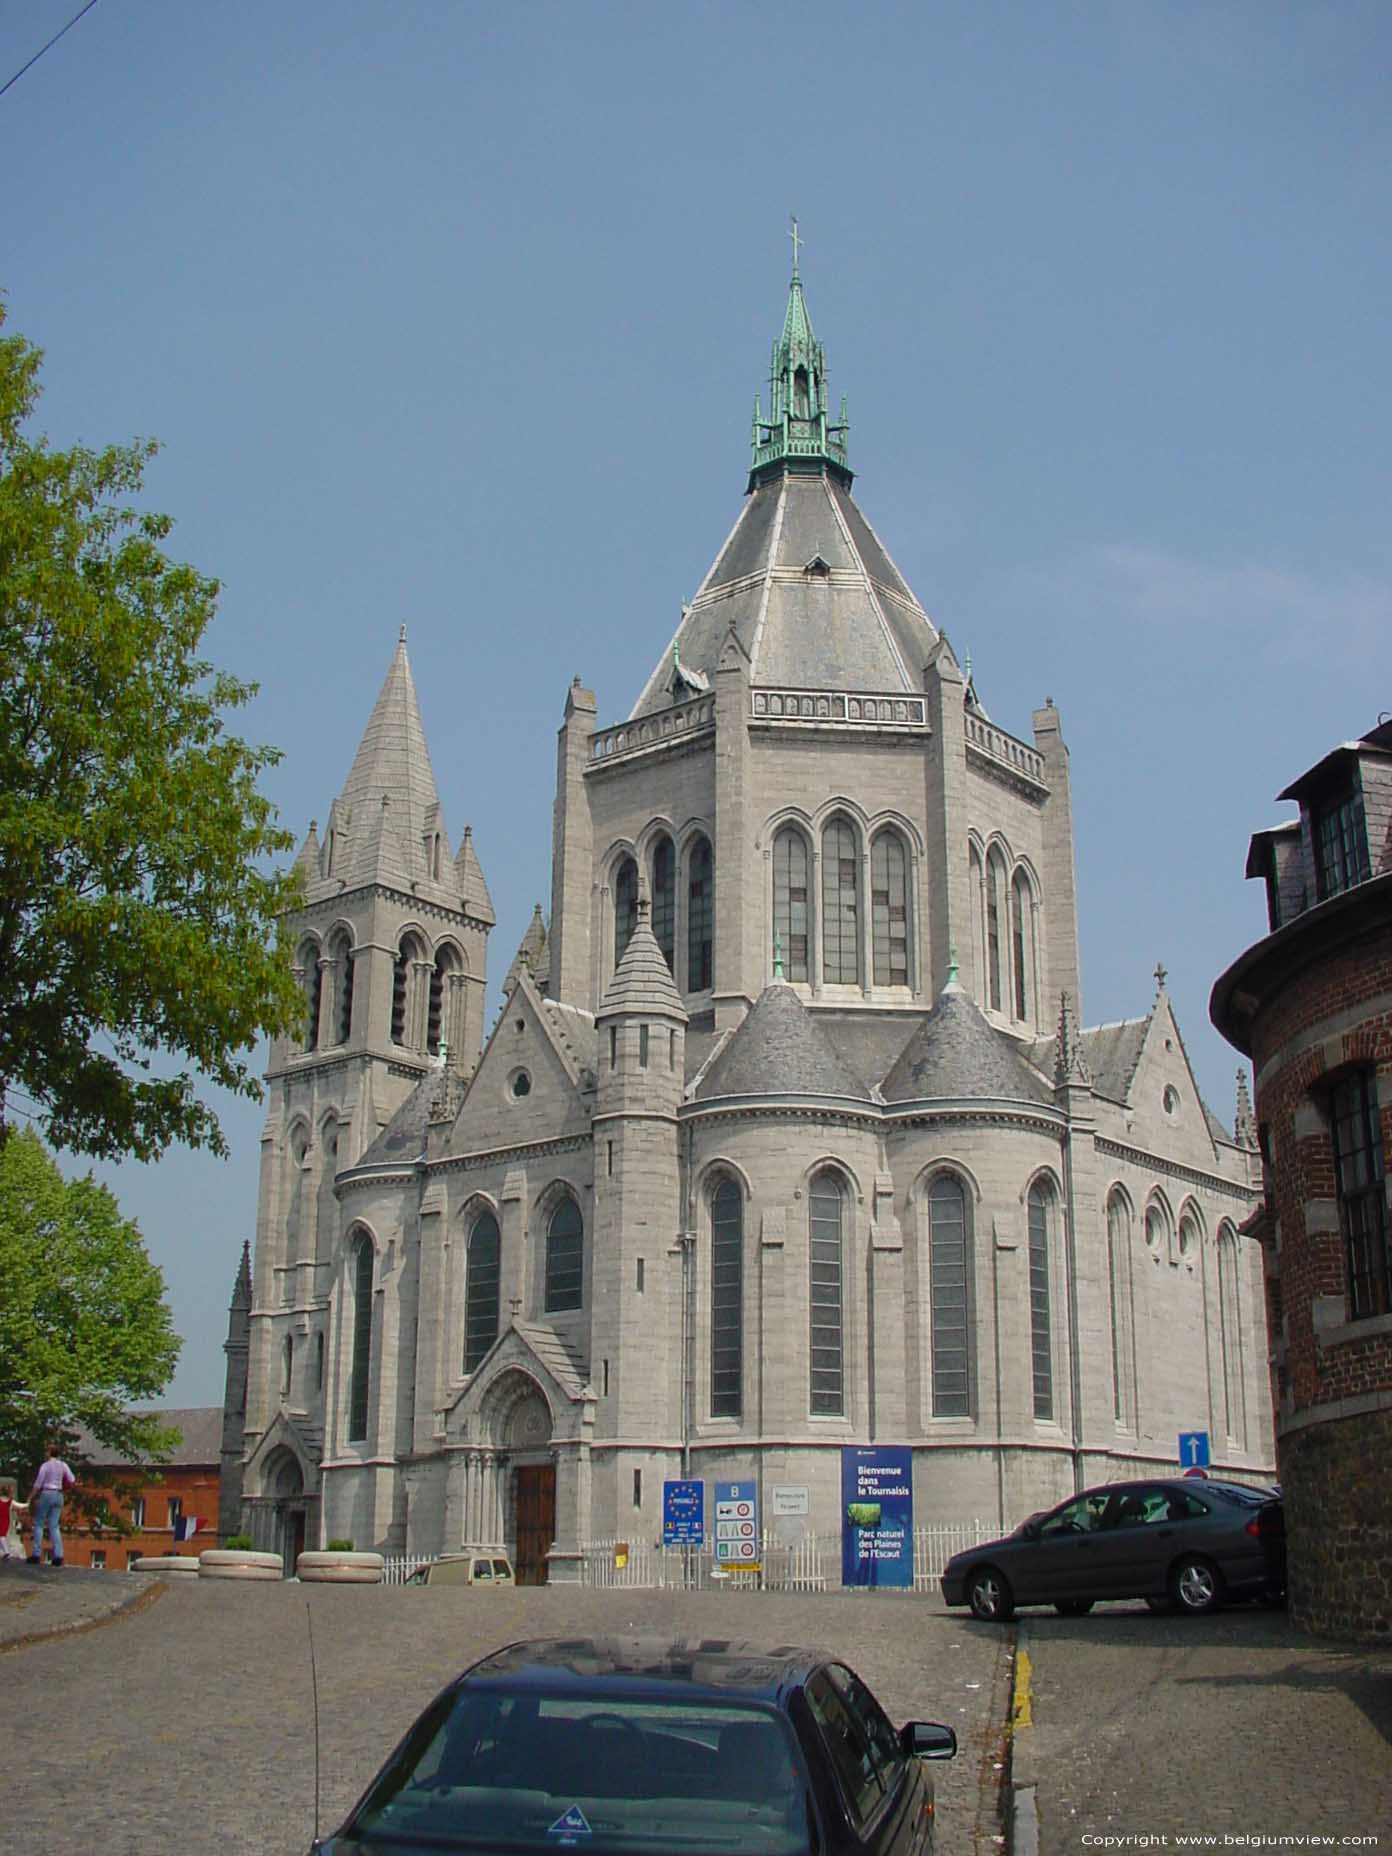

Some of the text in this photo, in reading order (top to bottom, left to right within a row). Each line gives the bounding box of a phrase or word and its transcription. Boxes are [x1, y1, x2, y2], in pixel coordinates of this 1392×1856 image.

[857, 1466, 902, 1475] Bienvenue
[857, 1476, 879, 1485] dans
[857, 1486, 910, 1496] le Tournaisis
[858, 1529, 905, 1538] Parc naturel
[858, 1539, 902, 1549] des Plaines
[858, 1549, 869, 1558] de
